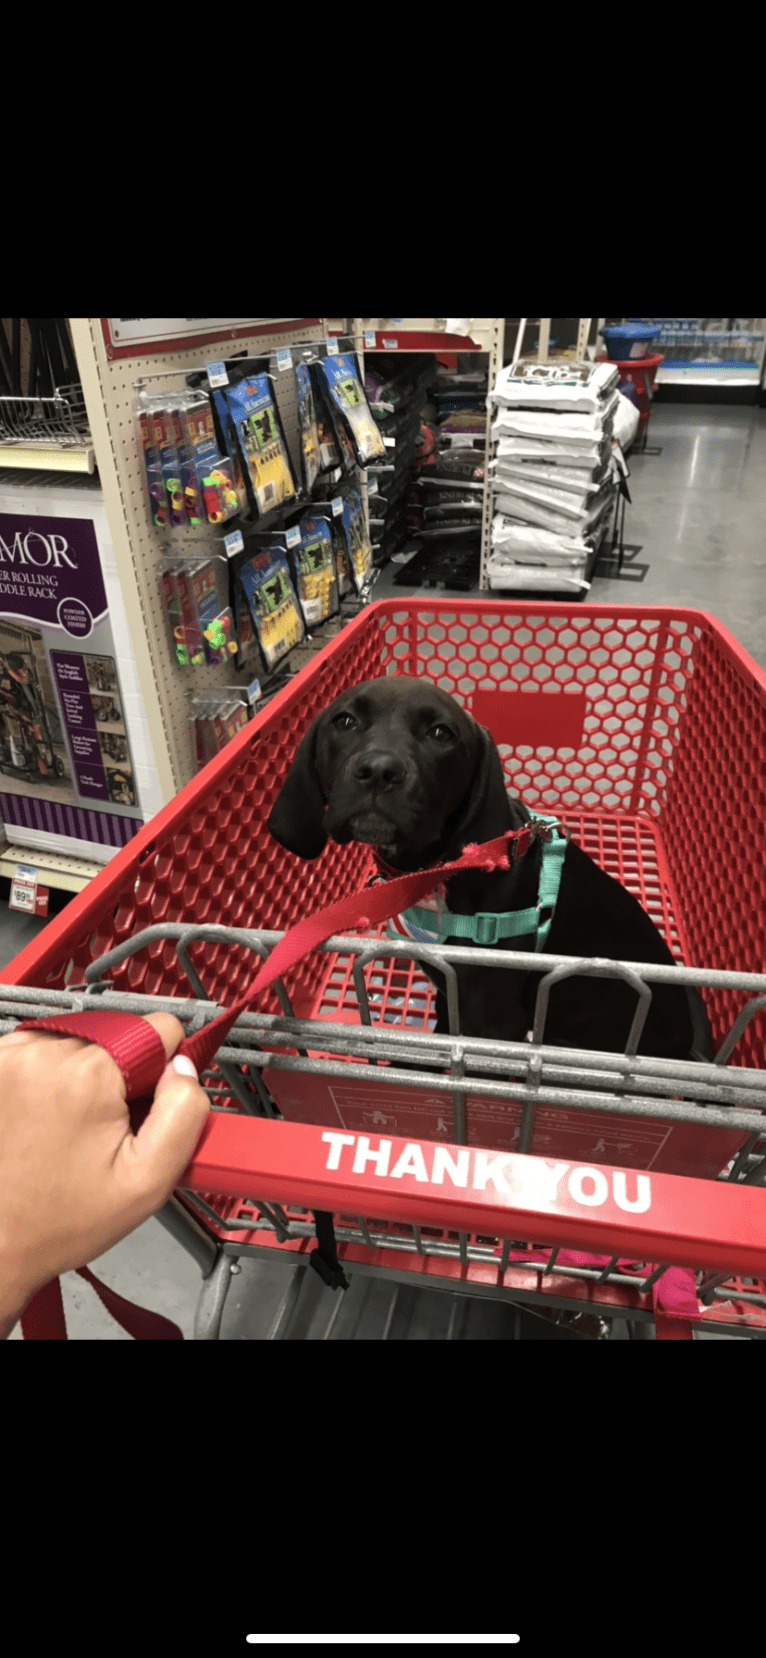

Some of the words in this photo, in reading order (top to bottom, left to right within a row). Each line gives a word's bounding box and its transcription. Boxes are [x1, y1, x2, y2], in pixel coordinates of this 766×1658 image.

[0, 531, 78, 569] MOR
[11, 571, 58, 587] ROLLING
[27, 586, 57, 599] RACK
[322, 1131, 513, 1194] THANK
[529, 1160, 652, 1214] YOU
